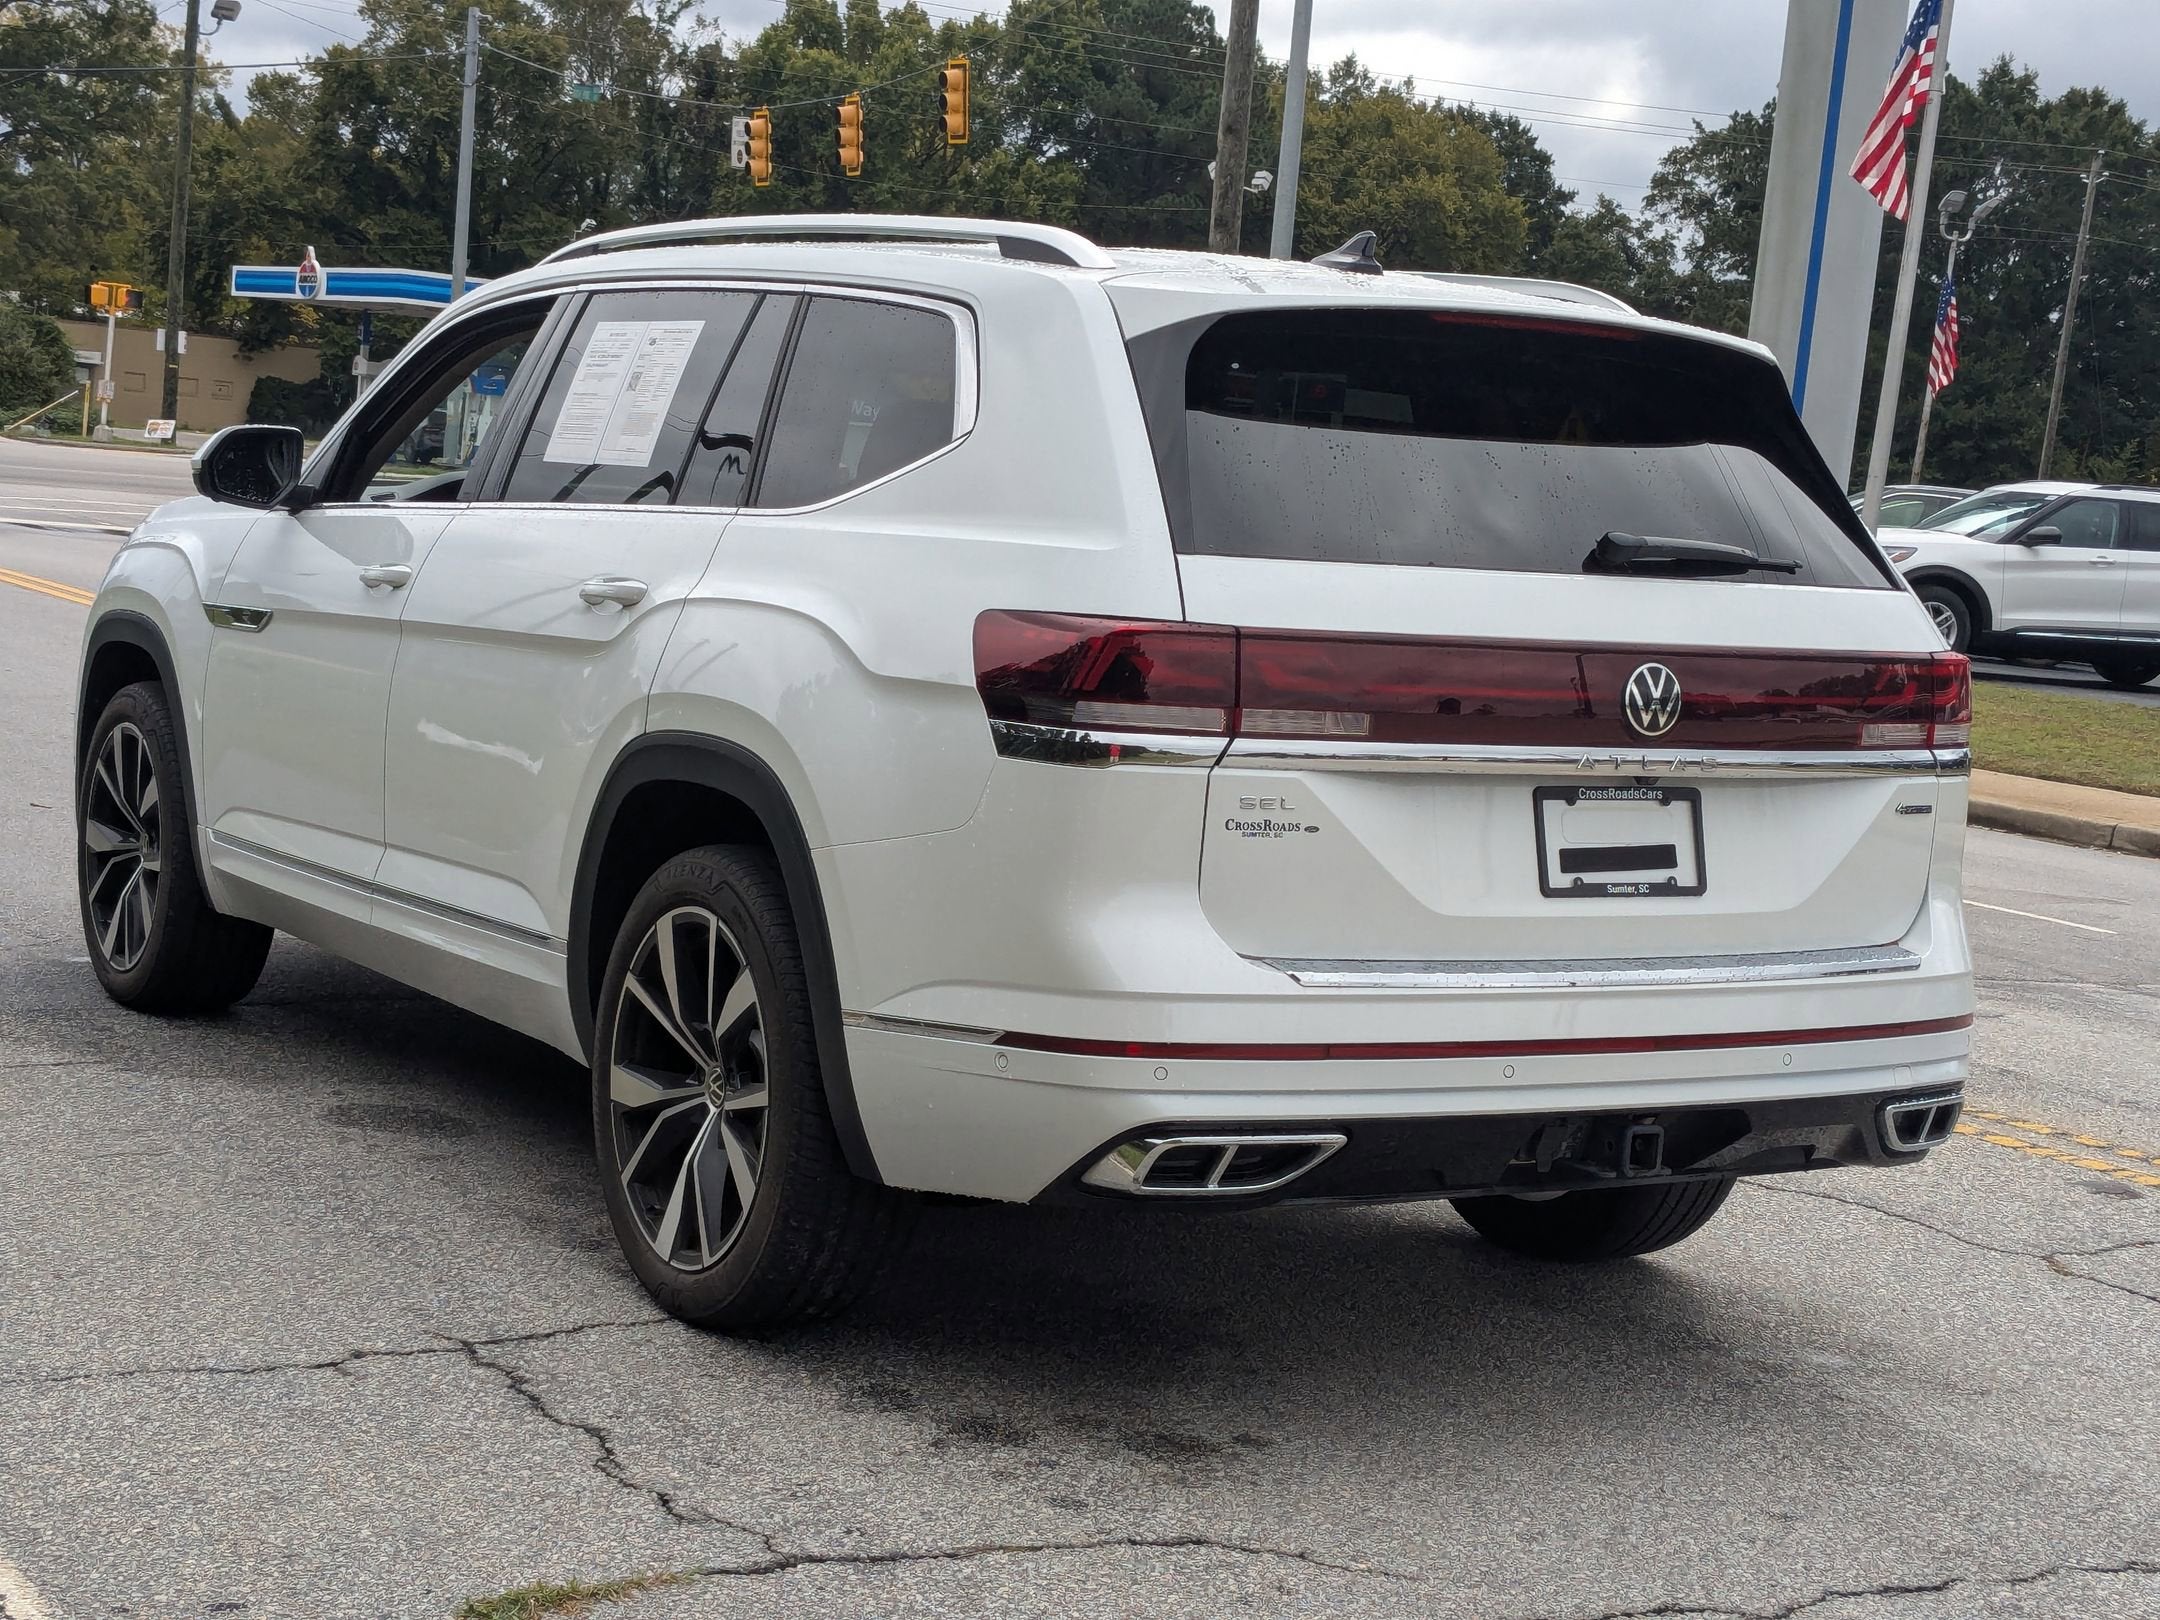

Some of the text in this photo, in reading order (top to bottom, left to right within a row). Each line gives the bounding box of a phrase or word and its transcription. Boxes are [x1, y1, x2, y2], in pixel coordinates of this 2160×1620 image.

[1575, 752, 1719, 772] ATLAS
[1578, 788, 1663, 800] CrossRoadsCars
[1239, 795, 1296, 810] SEL
[1607, 884, 1650, 895] Sumter, SC
